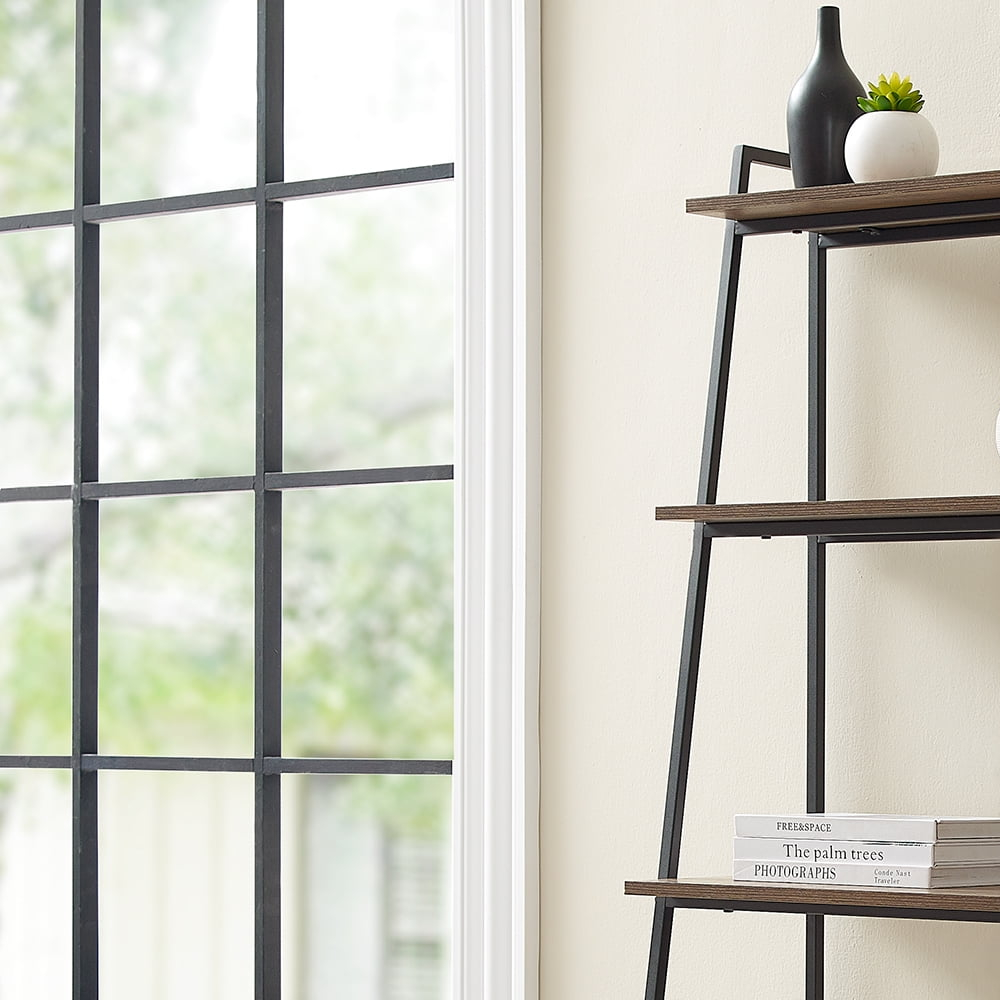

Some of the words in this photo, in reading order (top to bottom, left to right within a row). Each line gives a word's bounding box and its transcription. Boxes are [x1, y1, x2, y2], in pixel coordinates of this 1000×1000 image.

[776, 822, 832, 832] FREE&SPACE
[783, 844, 810, 858] The
[814, 845, 847, 862] palm
[851, 848, 884, 860] trees
[754, 864, 836, 880] PHOTOGRAPHS
